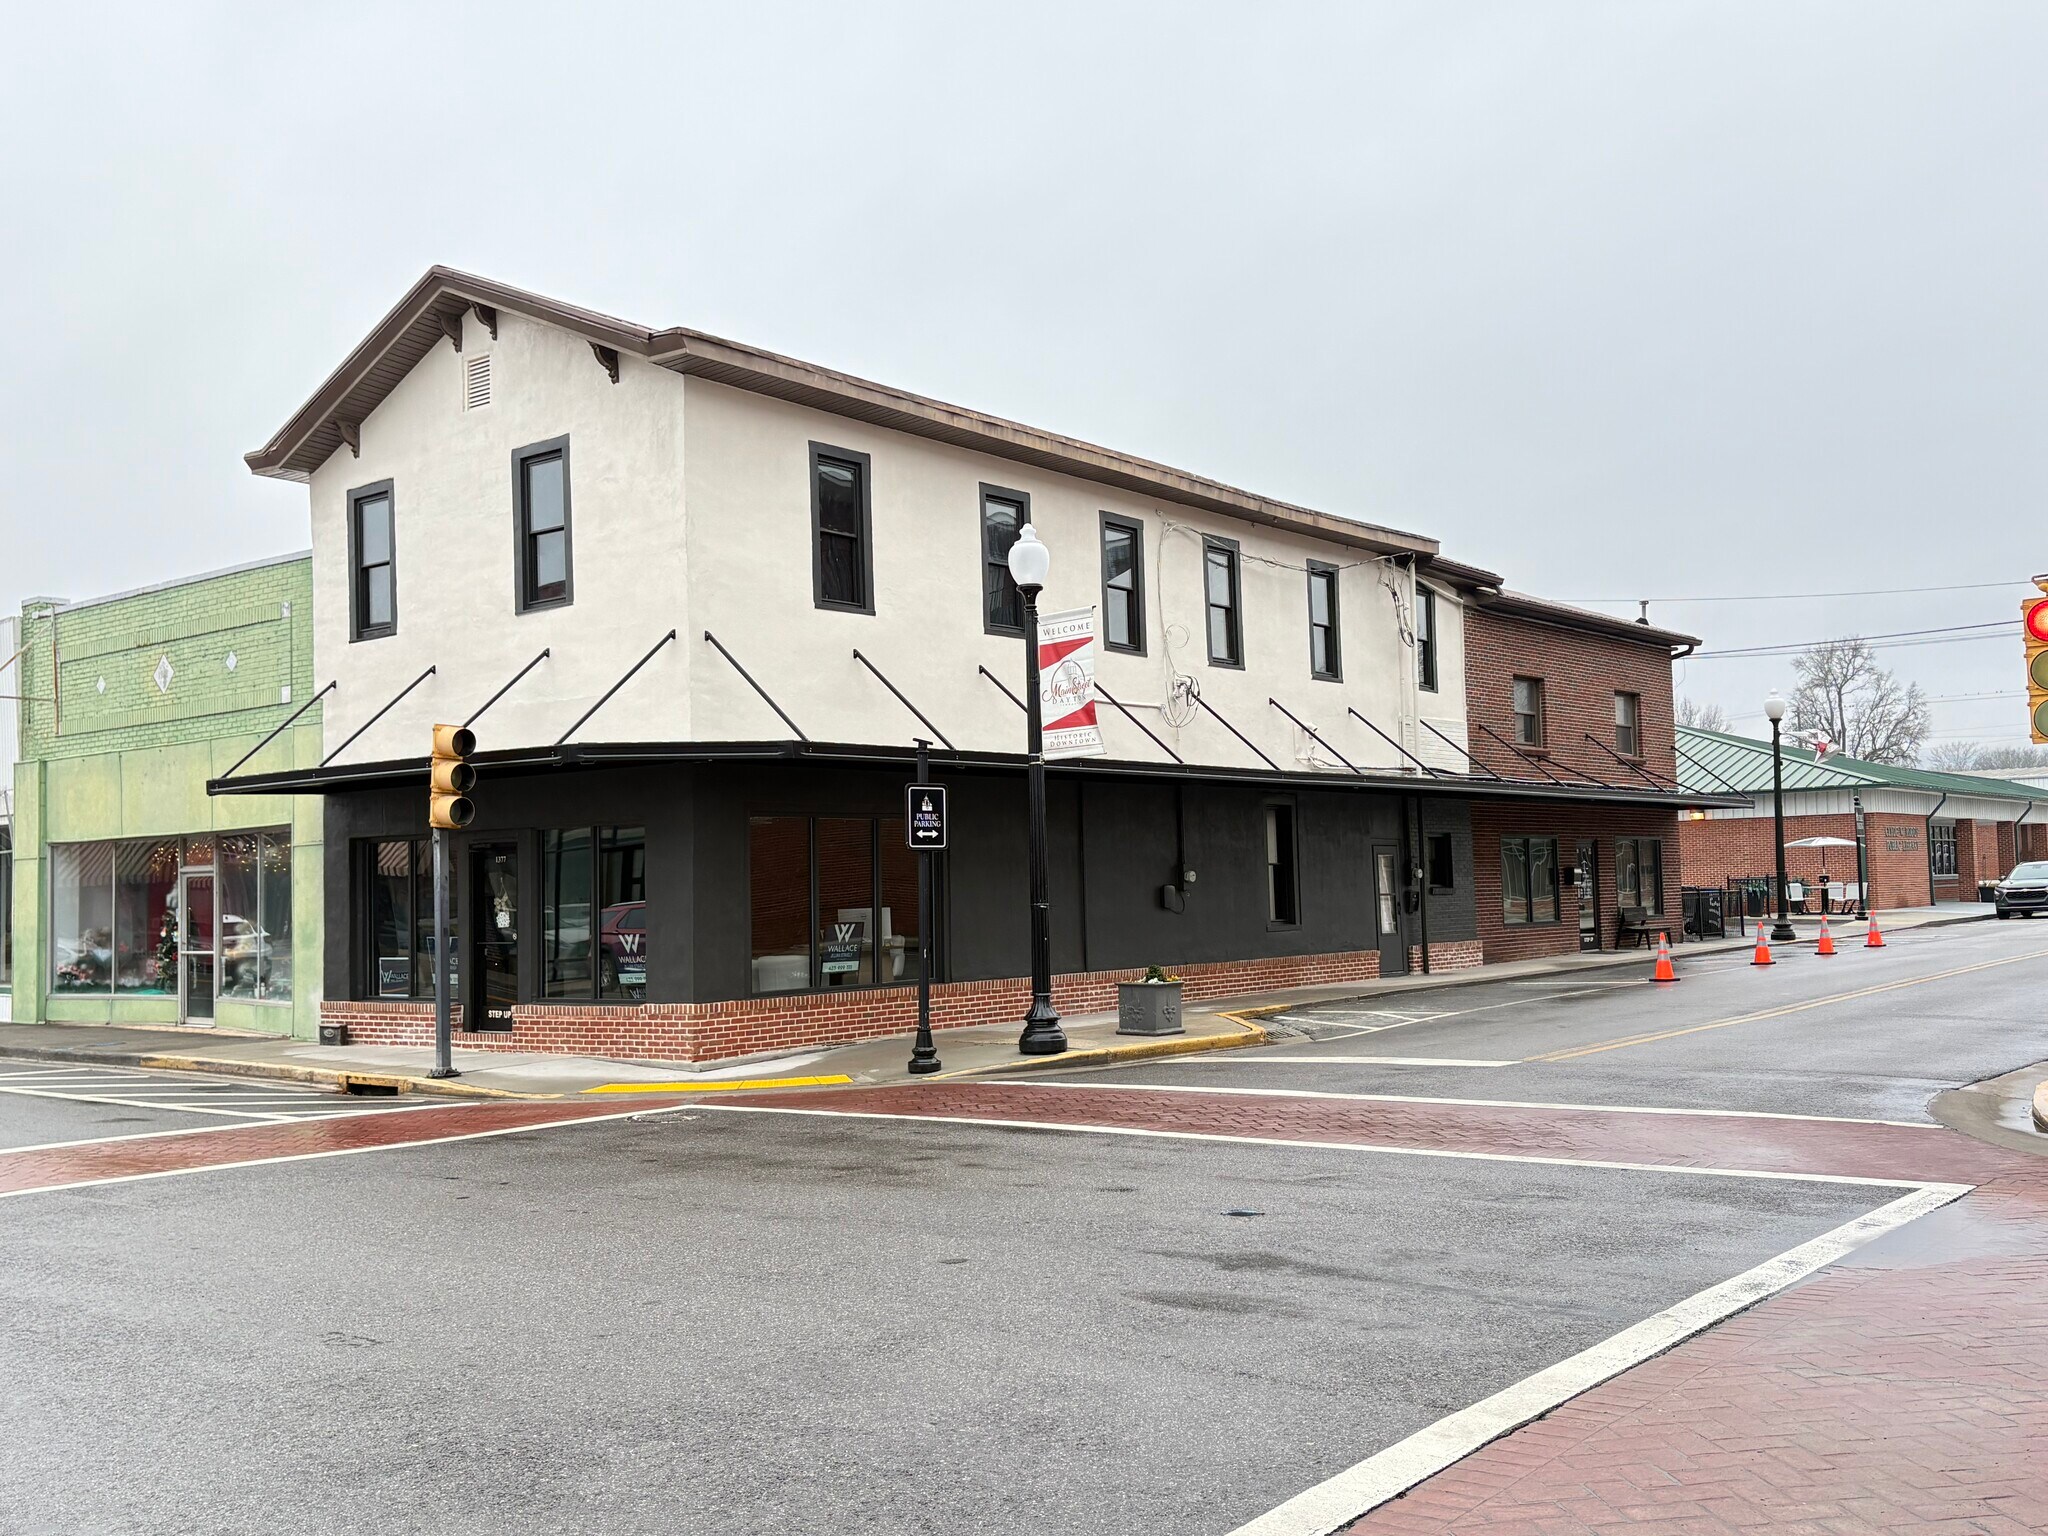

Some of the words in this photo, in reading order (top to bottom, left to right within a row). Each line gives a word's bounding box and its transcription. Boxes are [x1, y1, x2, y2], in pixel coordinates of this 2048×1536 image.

[1043, 622, 1090, 636] WELCOME
[1054, 731, 1092, 740] HISTORIC
[1050, 737, 1096, 748] DOWNTOWN
[916, 813, 939, 821] PUBLIC
[913, 820, 942, 828] PARKING
[828, 944, 858, 952] WALLACE
[618, 955, 647, 964] WALLAC
[488, 1009, 503, 1019] STEP
[503, 1010, 512, 1019] UP
